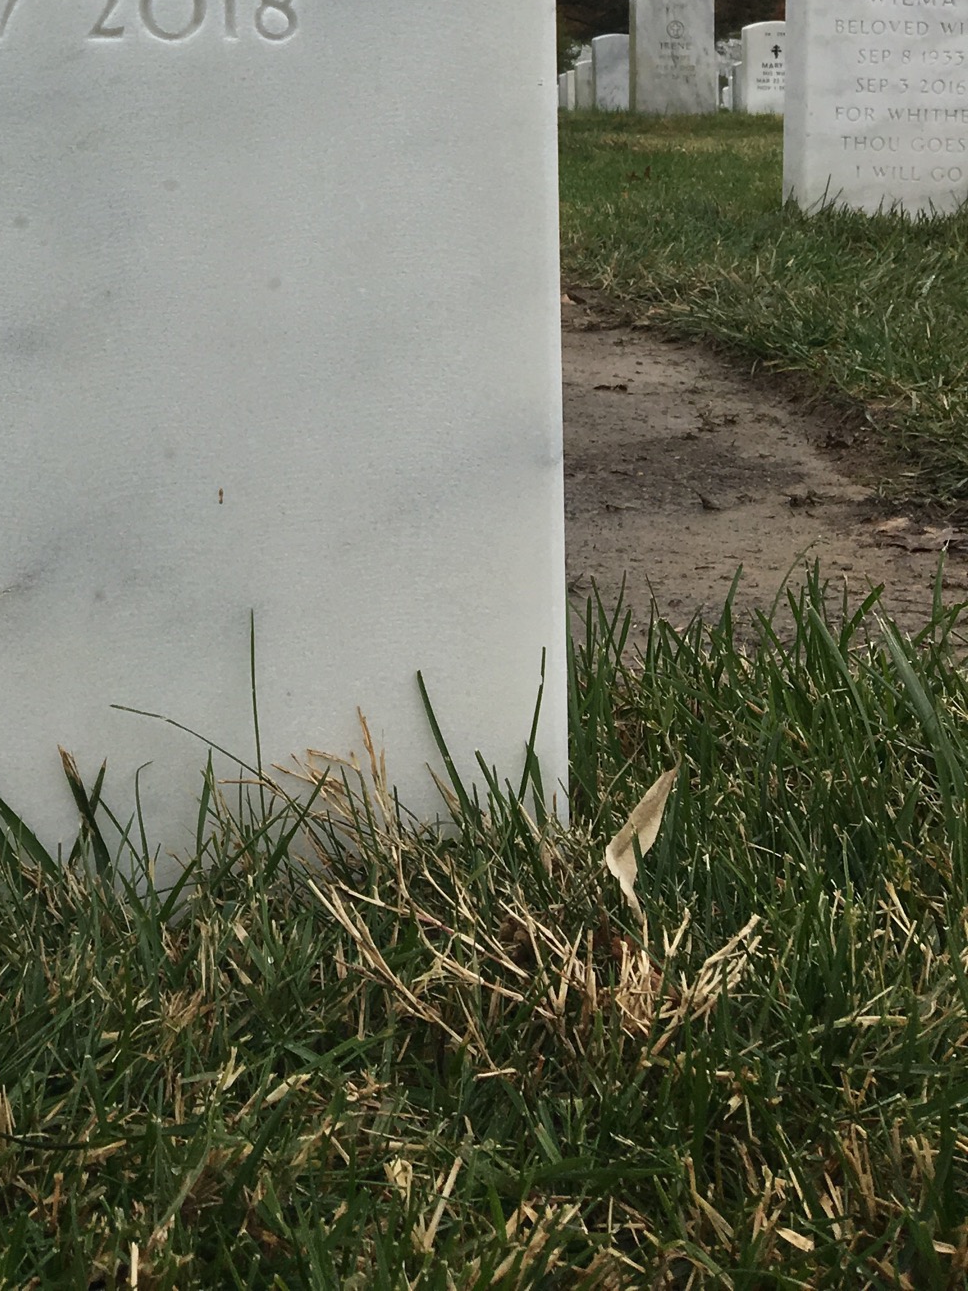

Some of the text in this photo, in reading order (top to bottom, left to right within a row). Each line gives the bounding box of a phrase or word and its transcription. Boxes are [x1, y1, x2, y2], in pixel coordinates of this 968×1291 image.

[835, 19, 929, 36] BELOVED
[857, 48, 891, 64] SEP
[901, 49, 912, 64] 8
[855, 77, 966, 95] SEP 3 2016
[835, 106, 875, 122] FOR
[840, 135, 900, 152] THOU
[872, 166, 921, 181] WILL
[931, 167, 963, 182] GO
